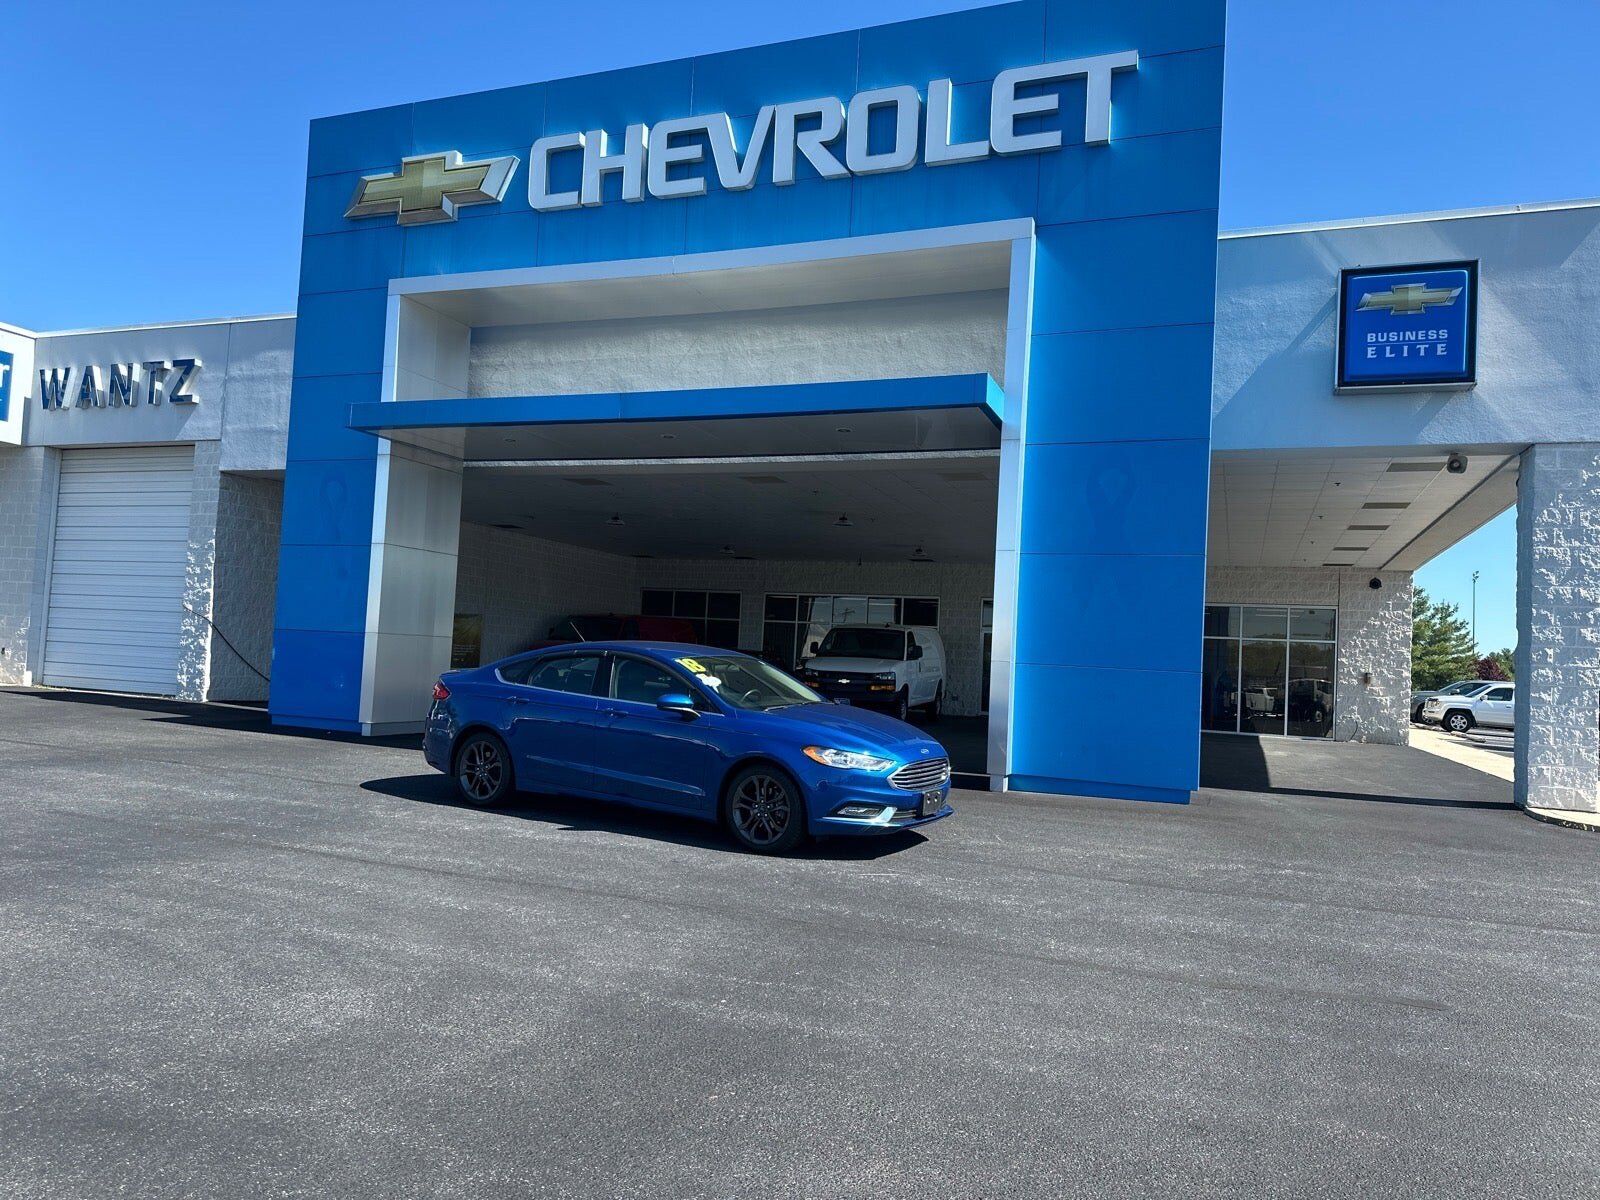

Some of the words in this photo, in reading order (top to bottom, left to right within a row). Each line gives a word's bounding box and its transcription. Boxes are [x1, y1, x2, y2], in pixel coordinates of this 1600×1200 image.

[528, 50, 1139, 212] CHEVROLET
[1366, 343, 1448, 359] ELITE
[1367, 329, 1449, 343] BUSINESS
[39, 358, 202, 411] WANTZ
